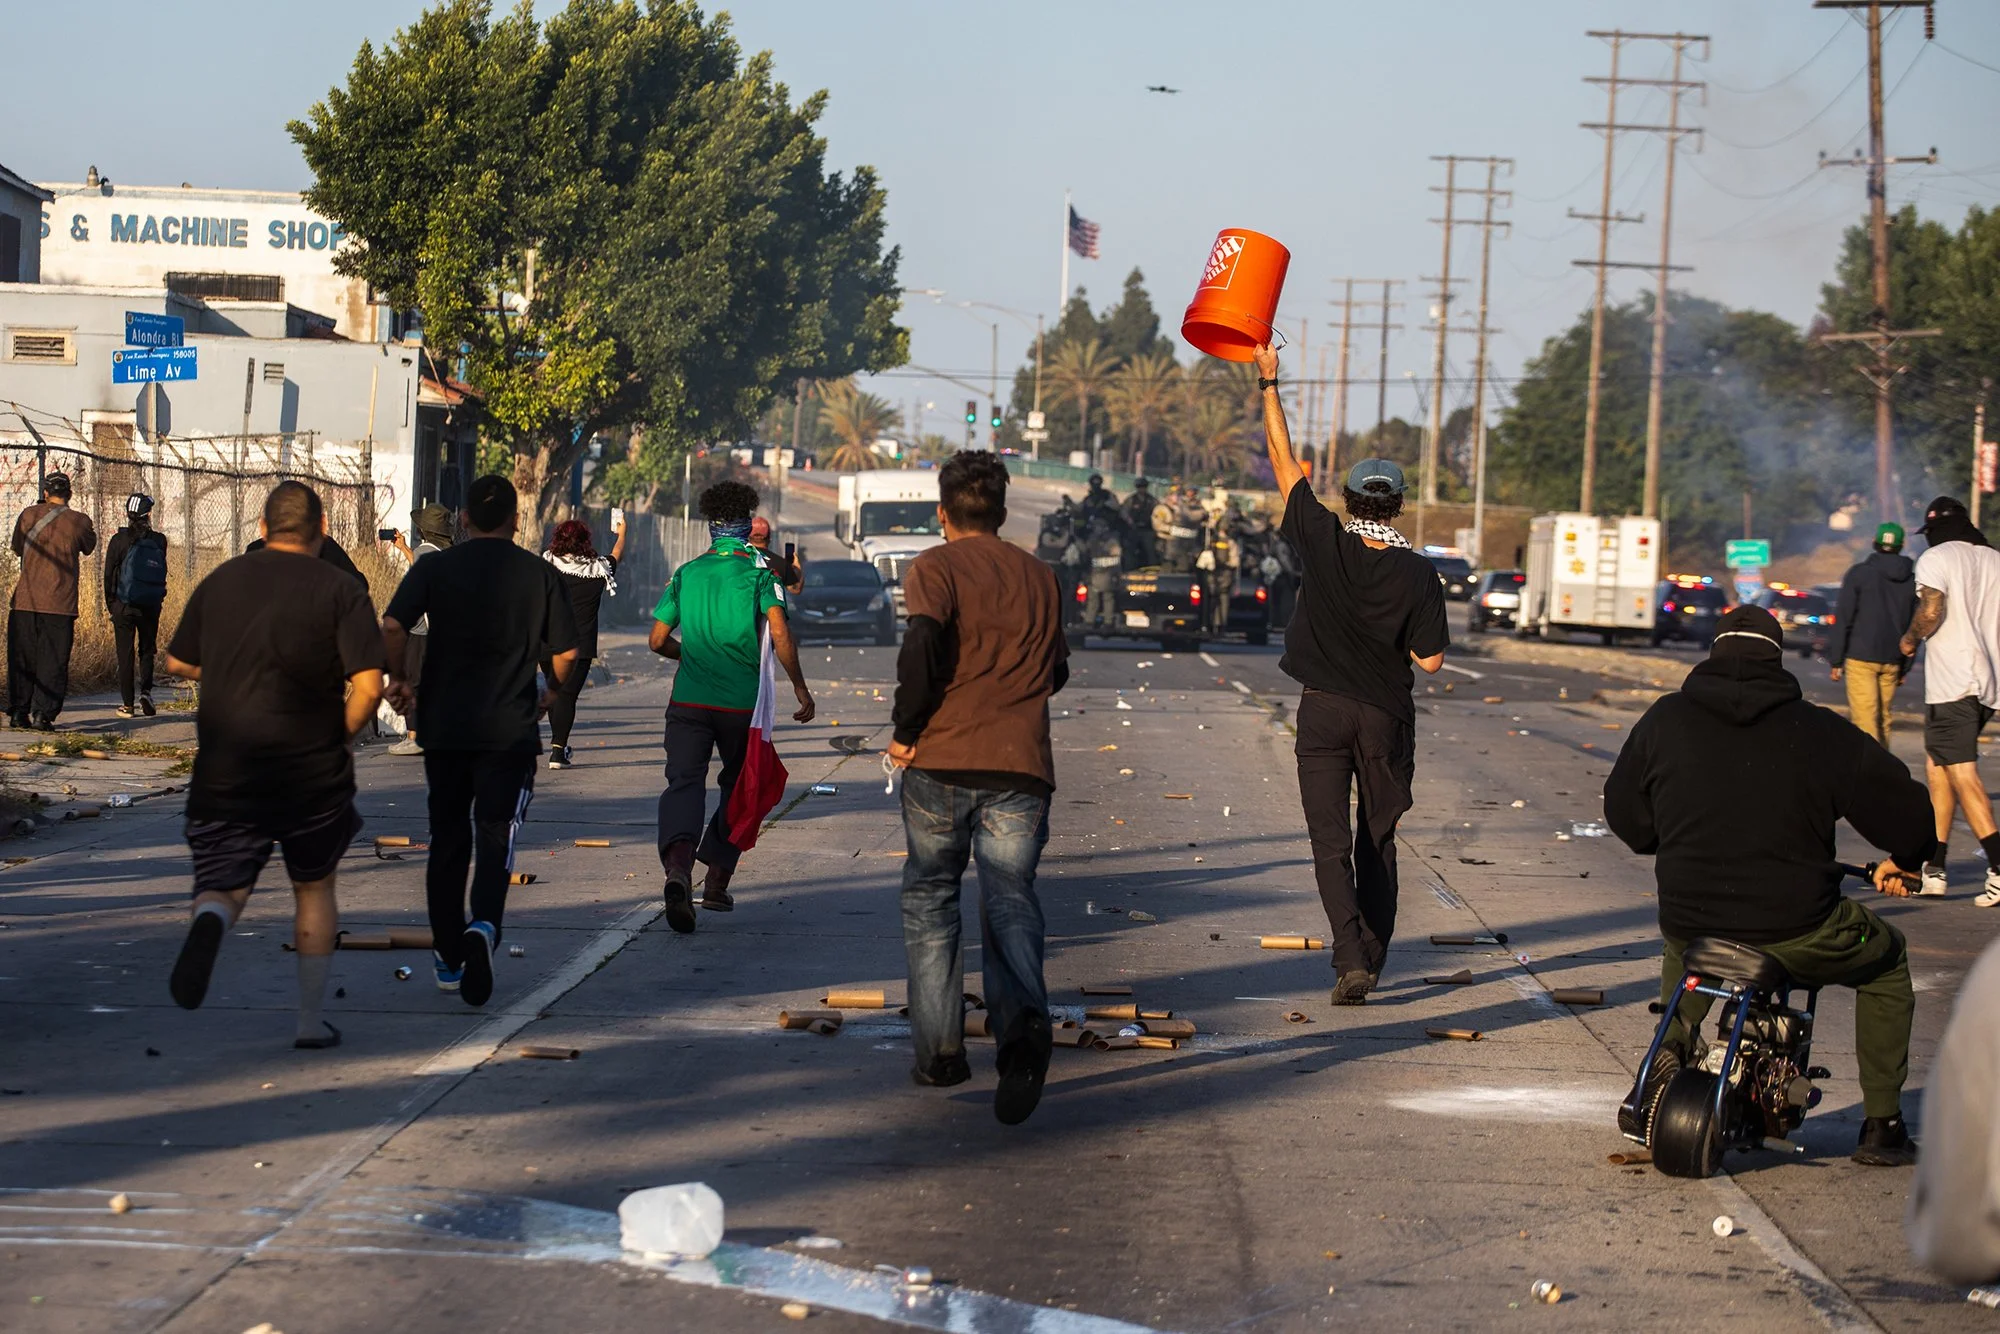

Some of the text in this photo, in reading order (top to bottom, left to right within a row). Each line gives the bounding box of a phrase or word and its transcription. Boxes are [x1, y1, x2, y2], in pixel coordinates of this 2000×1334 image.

[70, 213, 89, 242] &
[110, 213, 248, 248] MACHINE
[268, 219, 348, 251] SHOP
[131, 328, 167, 346] Alondra
[127, 363, 181, 380] Lime Av
